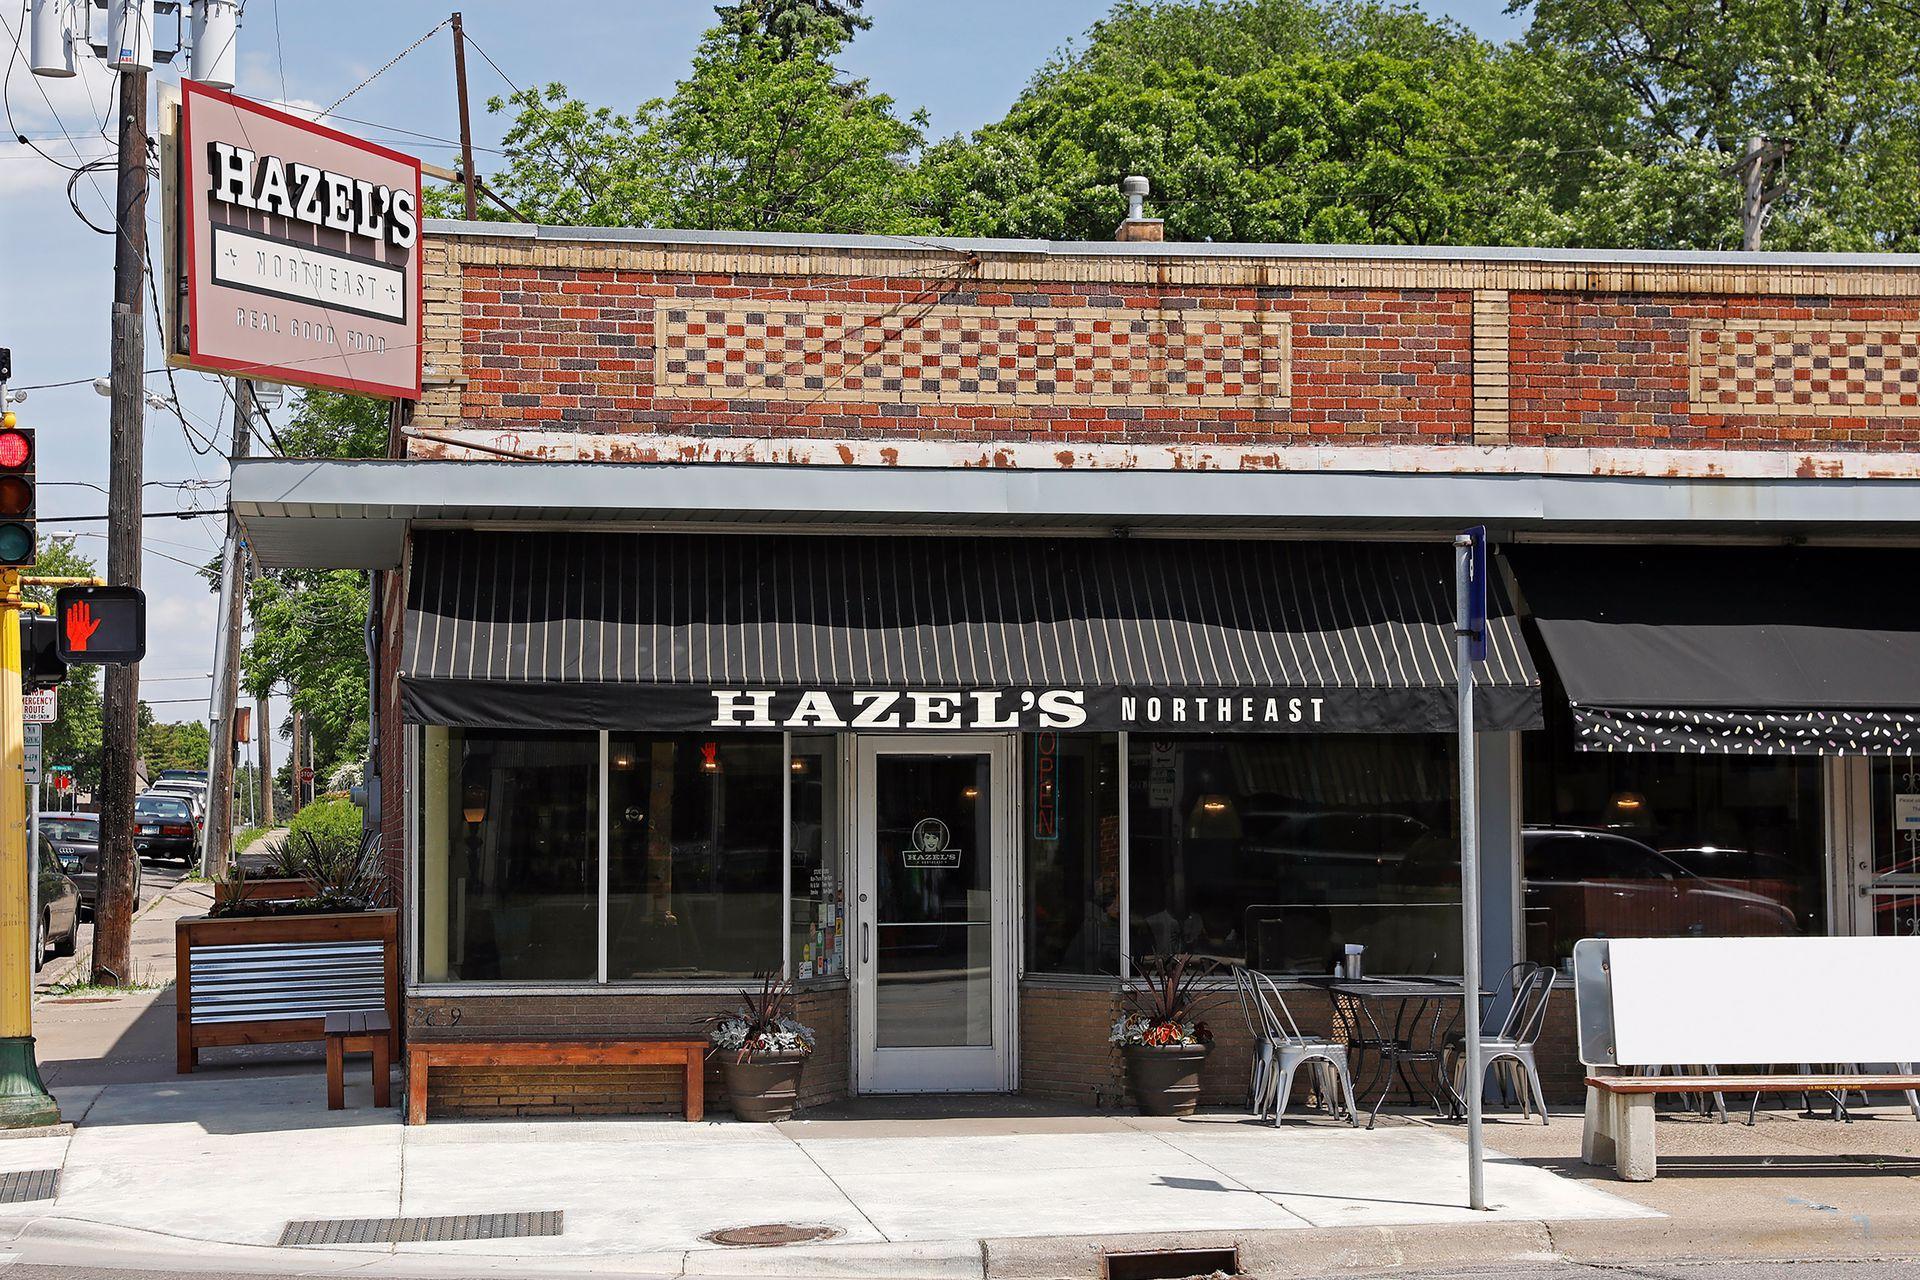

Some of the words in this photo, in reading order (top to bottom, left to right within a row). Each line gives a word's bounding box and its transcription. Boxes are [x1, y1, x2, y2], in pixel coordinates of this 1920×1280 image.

[210, 141, 417, 249] HAZEL'S
[256, 251, 376, 300] NORTHEAST
[236, 307, 280, 334] REAL
[290, 318, 334, 345] GOOD
[347, 330, 386, 355] FOOD
[24, 706, 45, 714] ROUTE
[711, 690, 1088, 729] HAZEL'S
[1121, 697, 1324, 722] NORTHEAST
[1039, 732, 1055, 834] OPEN
